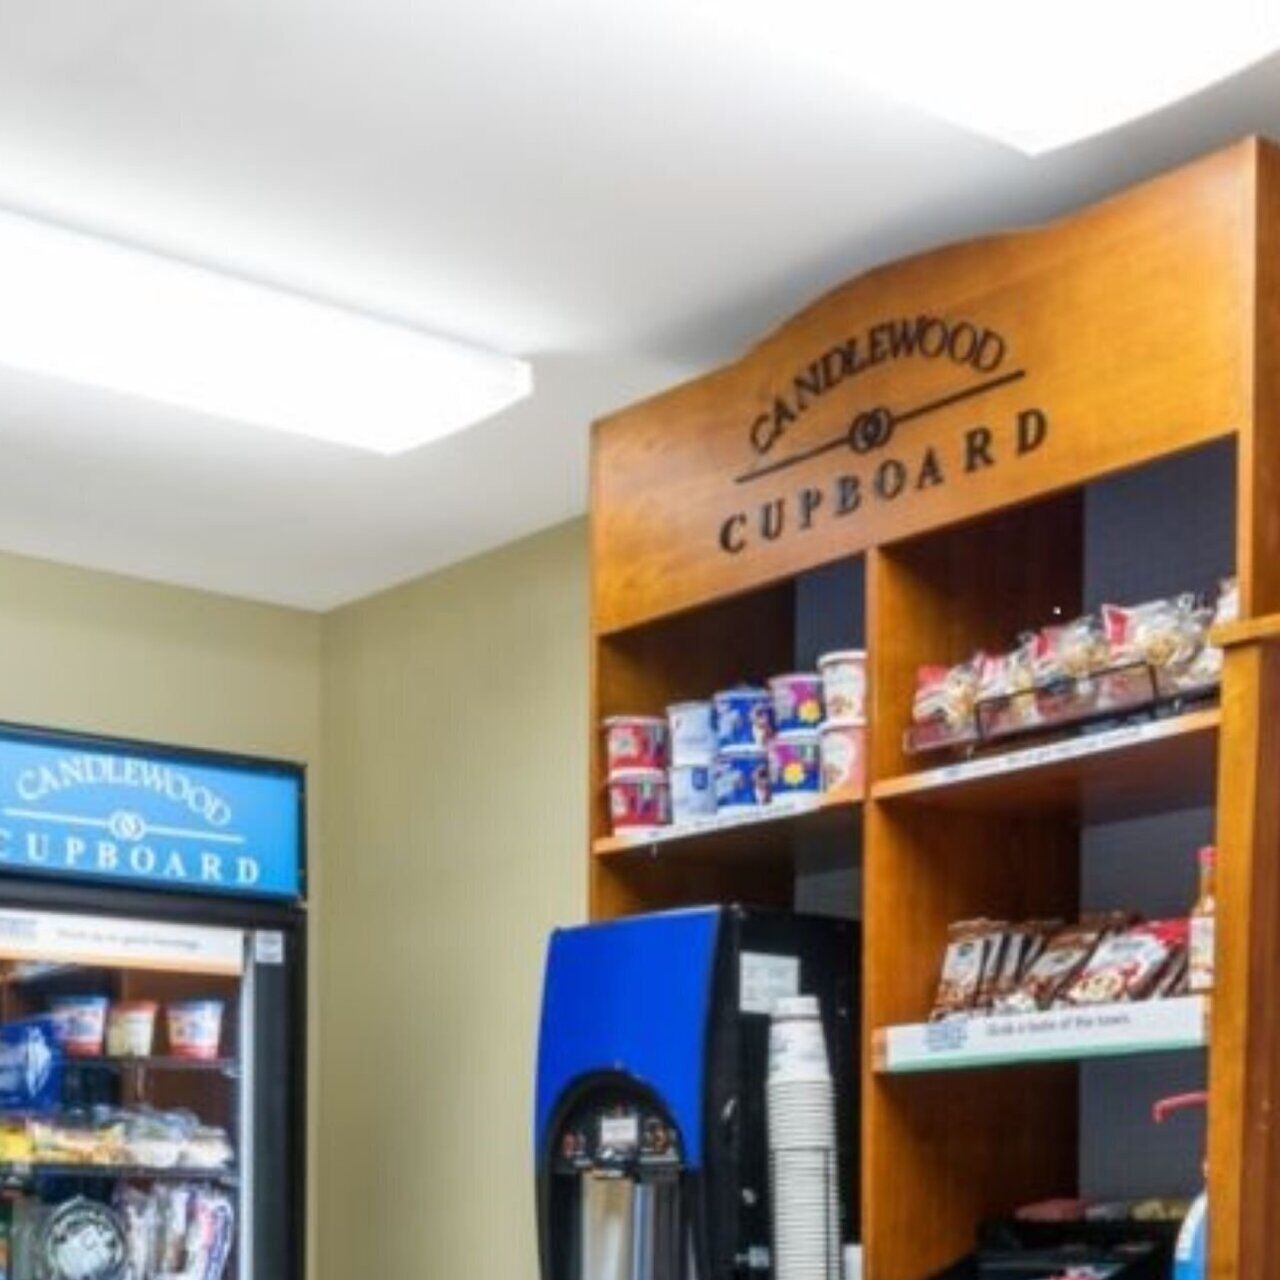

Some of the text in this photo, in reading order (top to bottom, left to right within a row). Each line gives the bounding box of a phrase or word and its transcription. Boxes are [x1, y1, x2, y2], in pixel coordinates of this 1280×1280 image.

[749, 313, 1006, 455] CANDLEWOOD
[718, 407, 1048, 554] CUPBOARD
[16, 753, 232, 827] CANDLEWOOD
